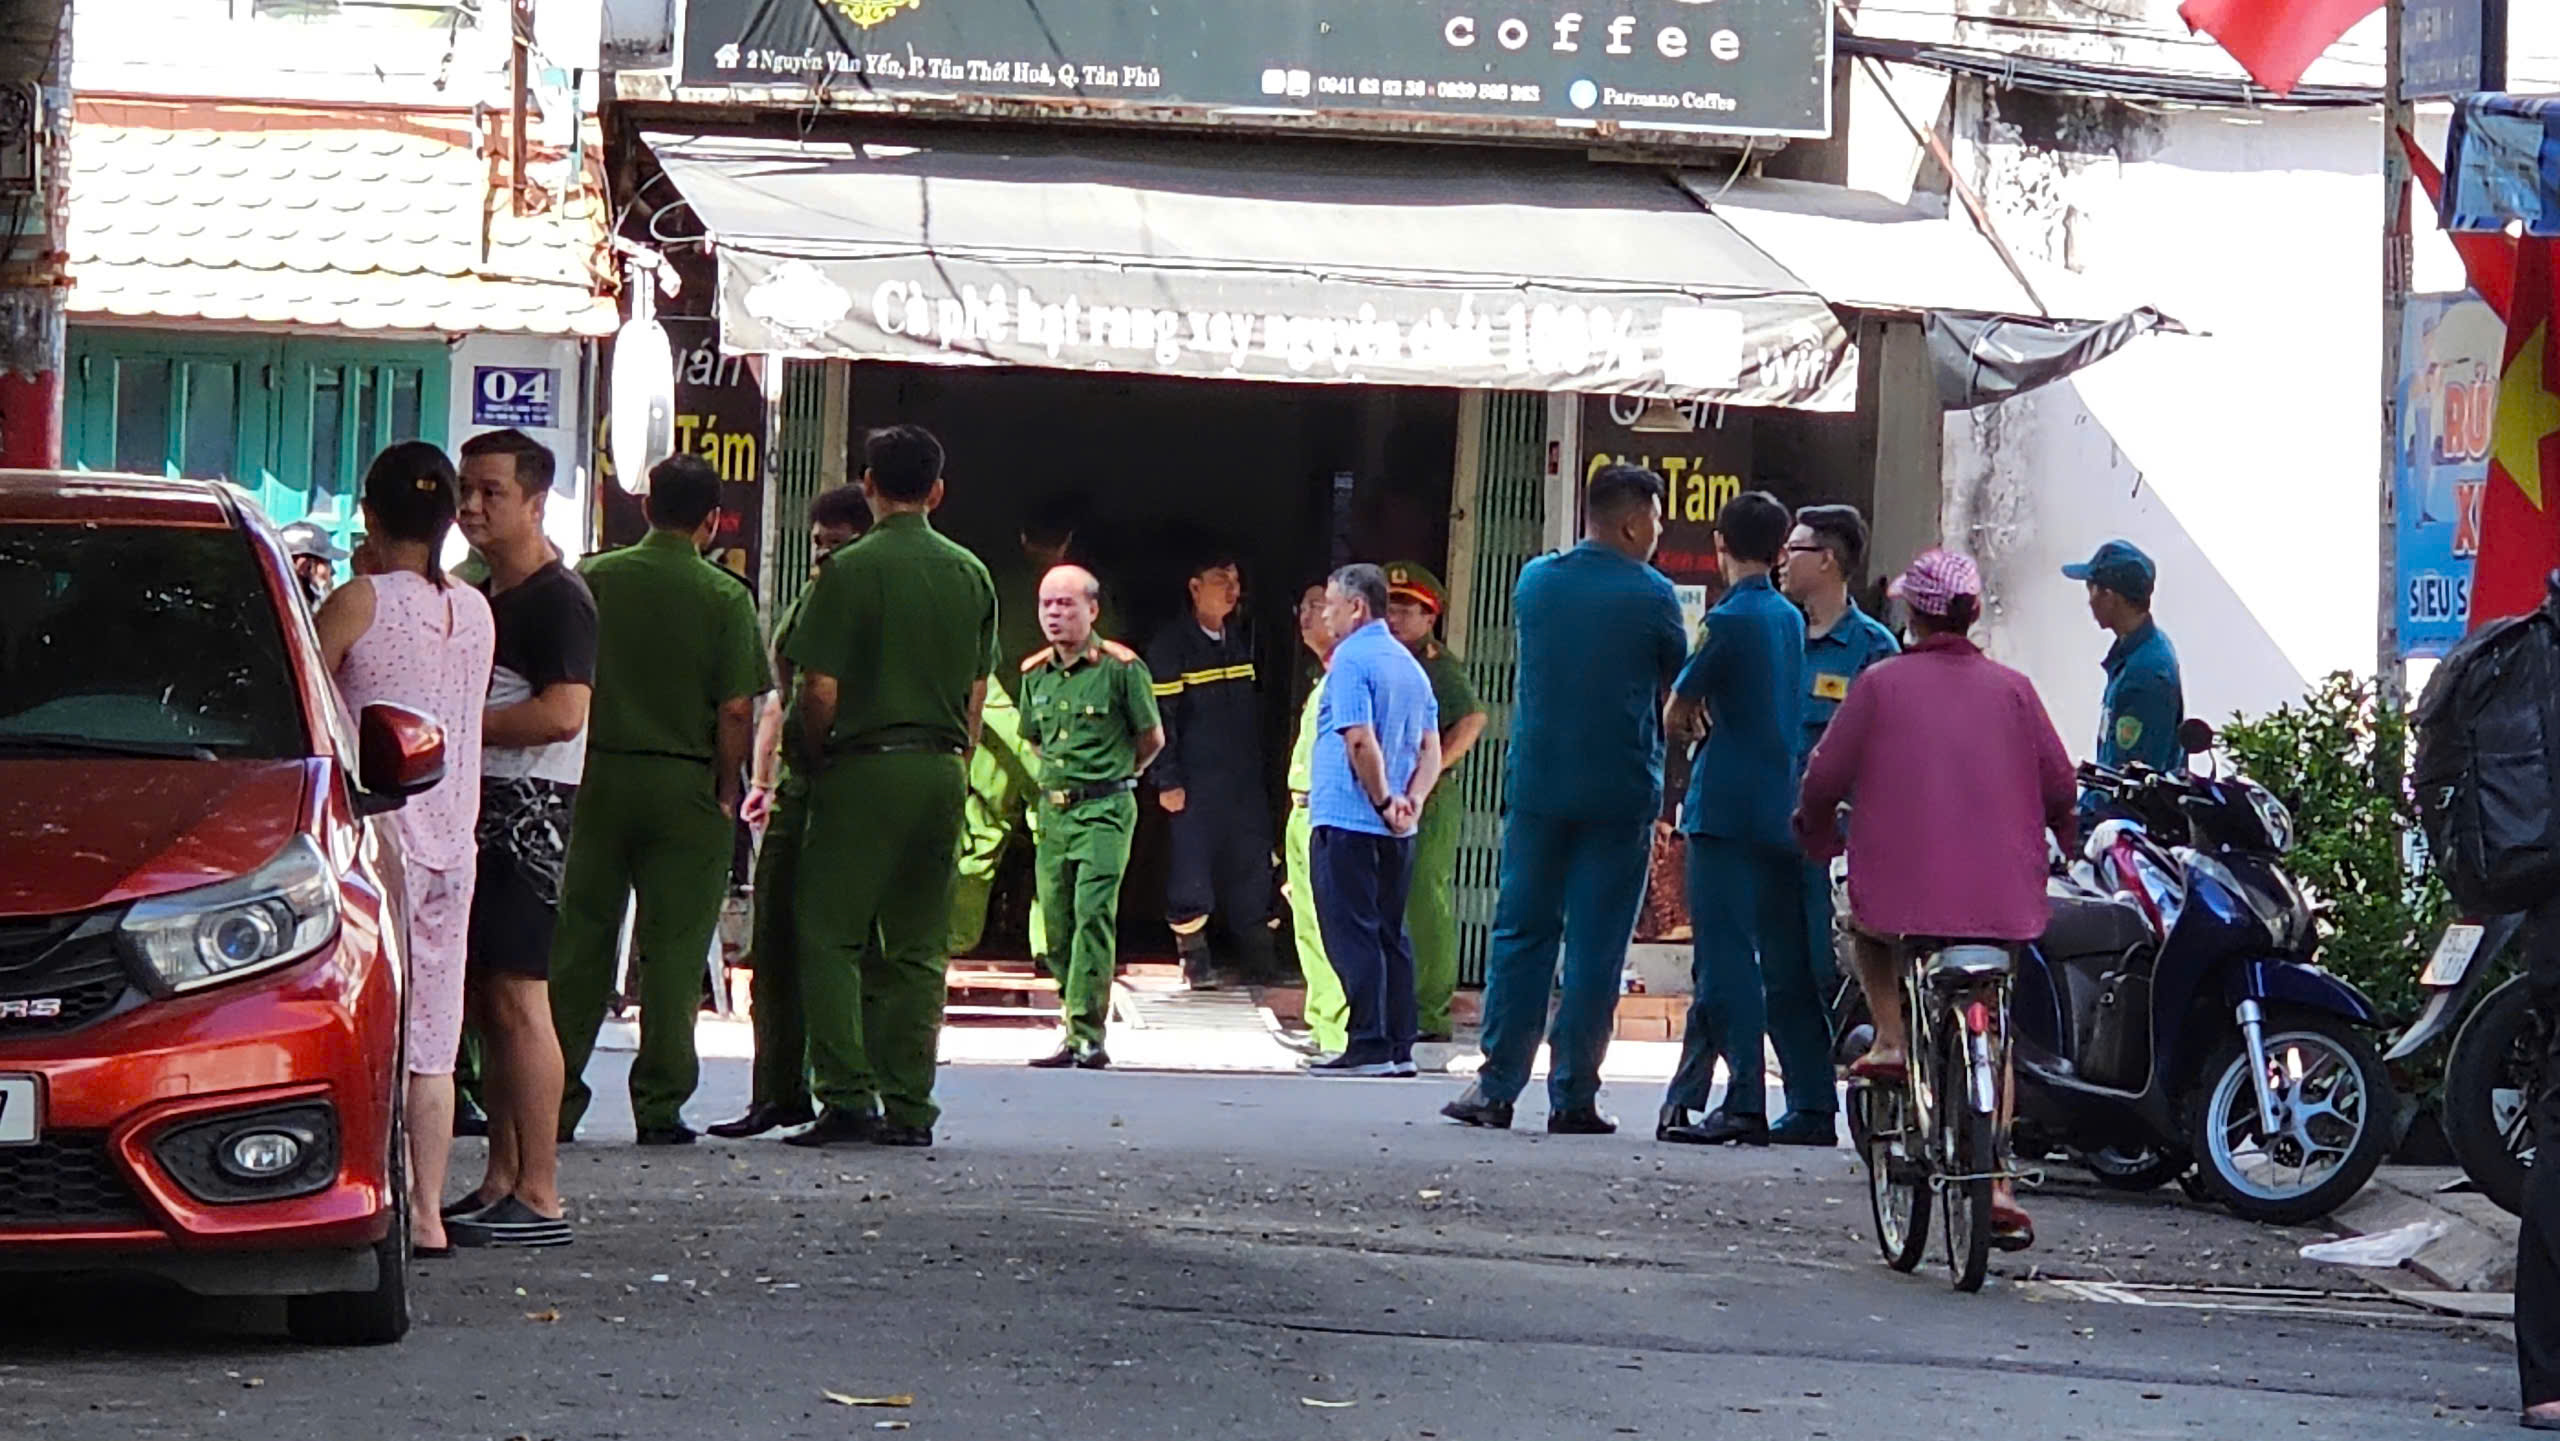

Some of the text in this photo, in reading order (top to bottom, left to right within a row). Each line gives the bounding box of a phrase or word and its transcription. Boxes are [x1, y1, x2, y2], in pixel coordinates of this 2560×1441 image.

[1444, 12, 1740, 61] coffee
[746, 50, 757, 69] 2
[1058, 64, 1079, 89] Q.
[1682, 91, 1737, 111] Coffee
[872, 279, 931, 336] Cà
[938, 283, 1008, 350] phê
[1017, 286, 1082, 360] hạt
[1090, 305, 1180, 366] rang
[1505, 302, 1645, 380] 100%
[483, 371, 552, 403] 04
[1661, 456, 1741, 522] Tám
[2456, 577, 2469, 616] S
